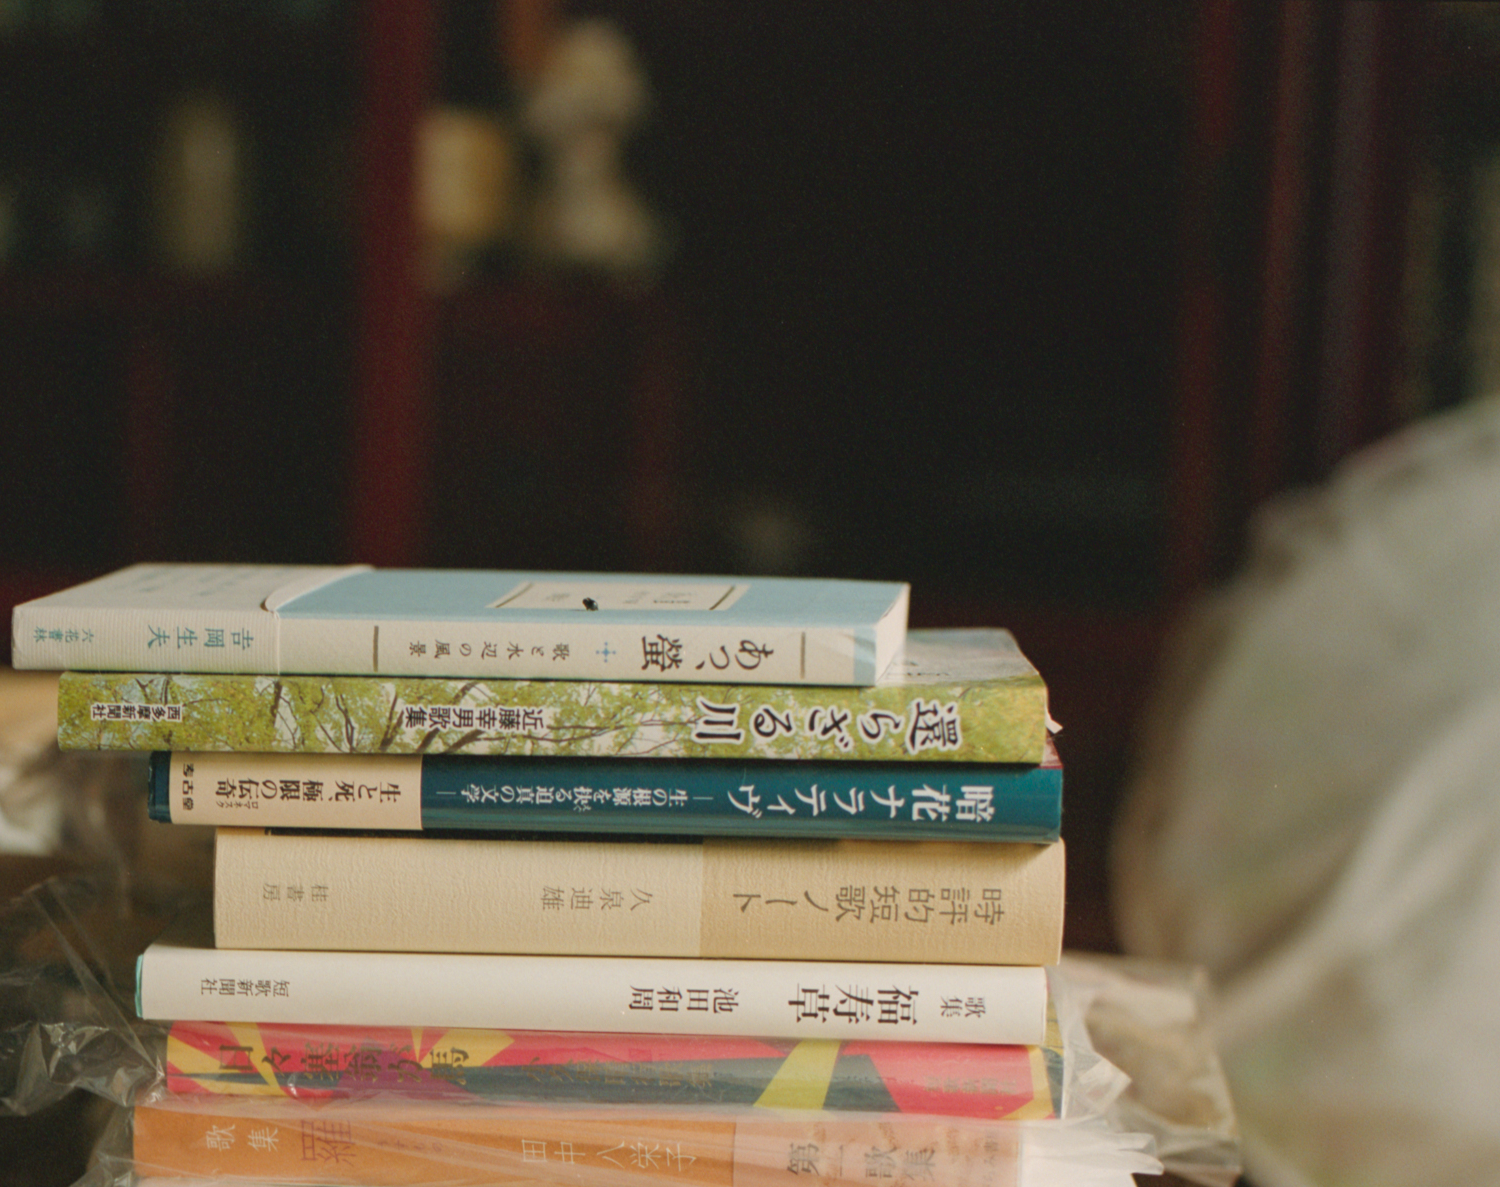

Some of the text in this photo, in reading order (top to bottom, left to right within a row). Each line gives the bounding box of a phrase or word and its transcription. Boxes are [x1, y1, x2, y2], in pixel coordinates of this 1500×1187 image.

[33, 626, 94, 644] 六花書林
[409, 640, 570, 661] 歌と水辺の風景
[92, 703, 182, 722] 西多摩新聞社
[404, 705, 547, 731] 近藤幸男歌集
[694, 699, 961, 753] 還らざる川
[216, 778, 402, 805] 生と死、極限の伝奇
[727, 784, 995, 823] 暗花ナラティヴ
[263, 883, 329, 902] 桂書房
[541, 886, 653, 911] 久泉迪雄
[733, 885, 1005, 925] 時評的短歌ノート
[200, 978, 290, 998] 短歌新聞社
[629, 984, 740, 1014] 池田和周
[788, 984, 919, 1025] 福寿草
[940, 995, 987, 1018] 歌集
[219, 1041, 470, 1085] 日々塞翁が馬
[206, 1124, 280, 1153] 歌集
[300, 1118, 357, 1167] 羅
[521, 1138, 697, 1172] 田中八栄子
[787, 1142, 937, 1182] 第一歌集
